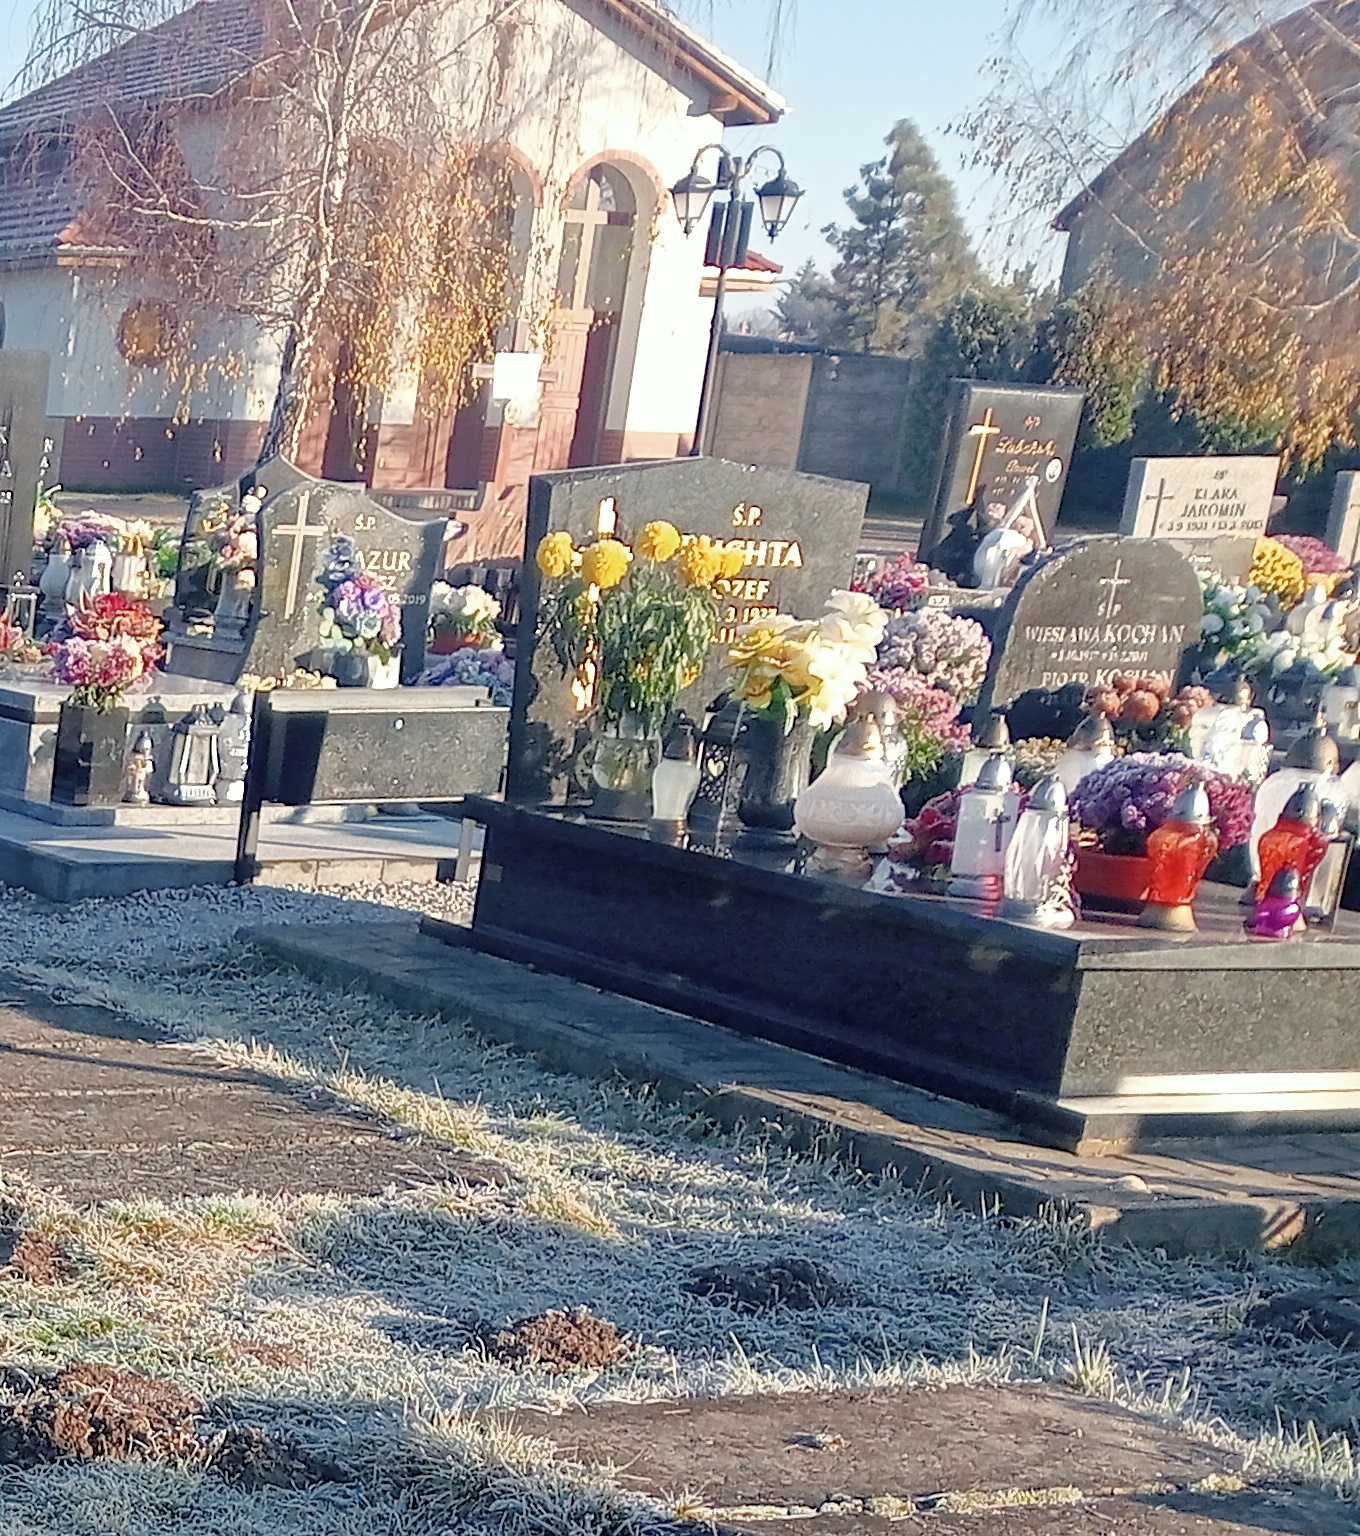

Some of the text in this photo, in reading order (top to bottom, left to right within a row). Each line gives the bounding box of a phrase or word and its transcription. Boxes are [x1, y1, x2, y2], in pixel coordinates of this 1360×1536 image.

[1194, 487, 1239, 500] KLARA
[731, 501, 762, 527] Ś.P.
[1180, 502, 1247, 518] JAROMIN
[354, 550, 412, 572] AZUR
[1103, 622, 1186, 644] KOCHAN
